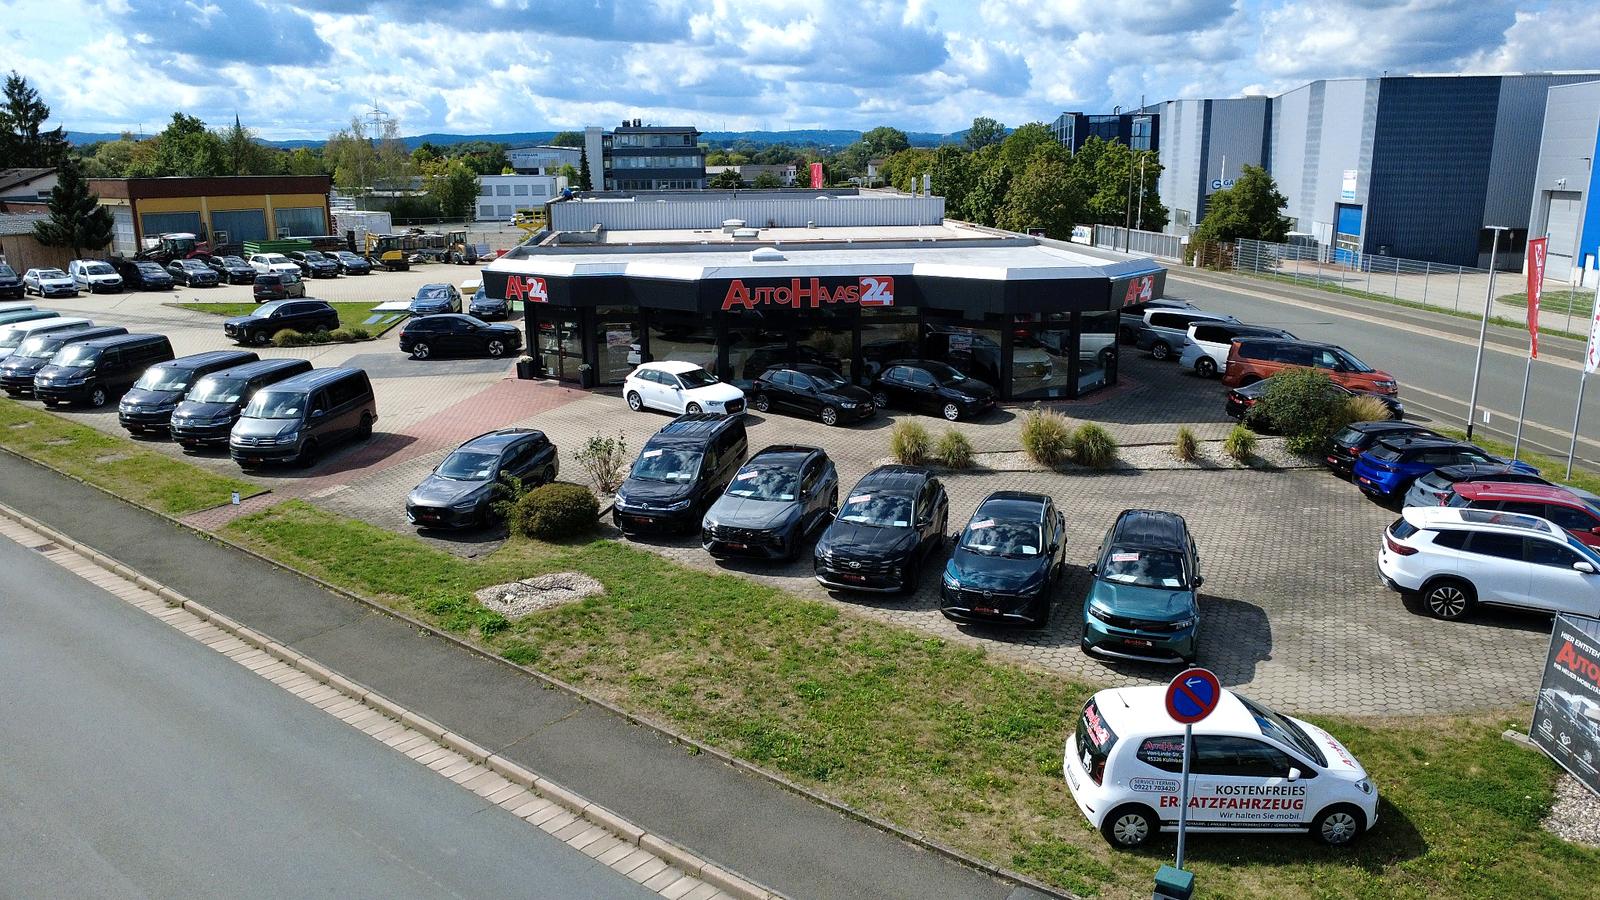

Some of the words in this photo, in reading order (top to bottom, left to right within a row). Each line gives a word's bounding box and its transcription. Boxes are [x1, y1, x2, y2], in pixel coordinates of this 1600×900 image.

[1560, 631, 1575, 645] HIER
[1555, 640, 1600, 688] AUTO
[1215, 785, 1306, 796] KOSTENFREIES
[1160, 796, 1304, 810] ERATZFAHRZEUG
[1235, 812, 1261, 820] halten
[1262, 812, 1275, 820] Sie
